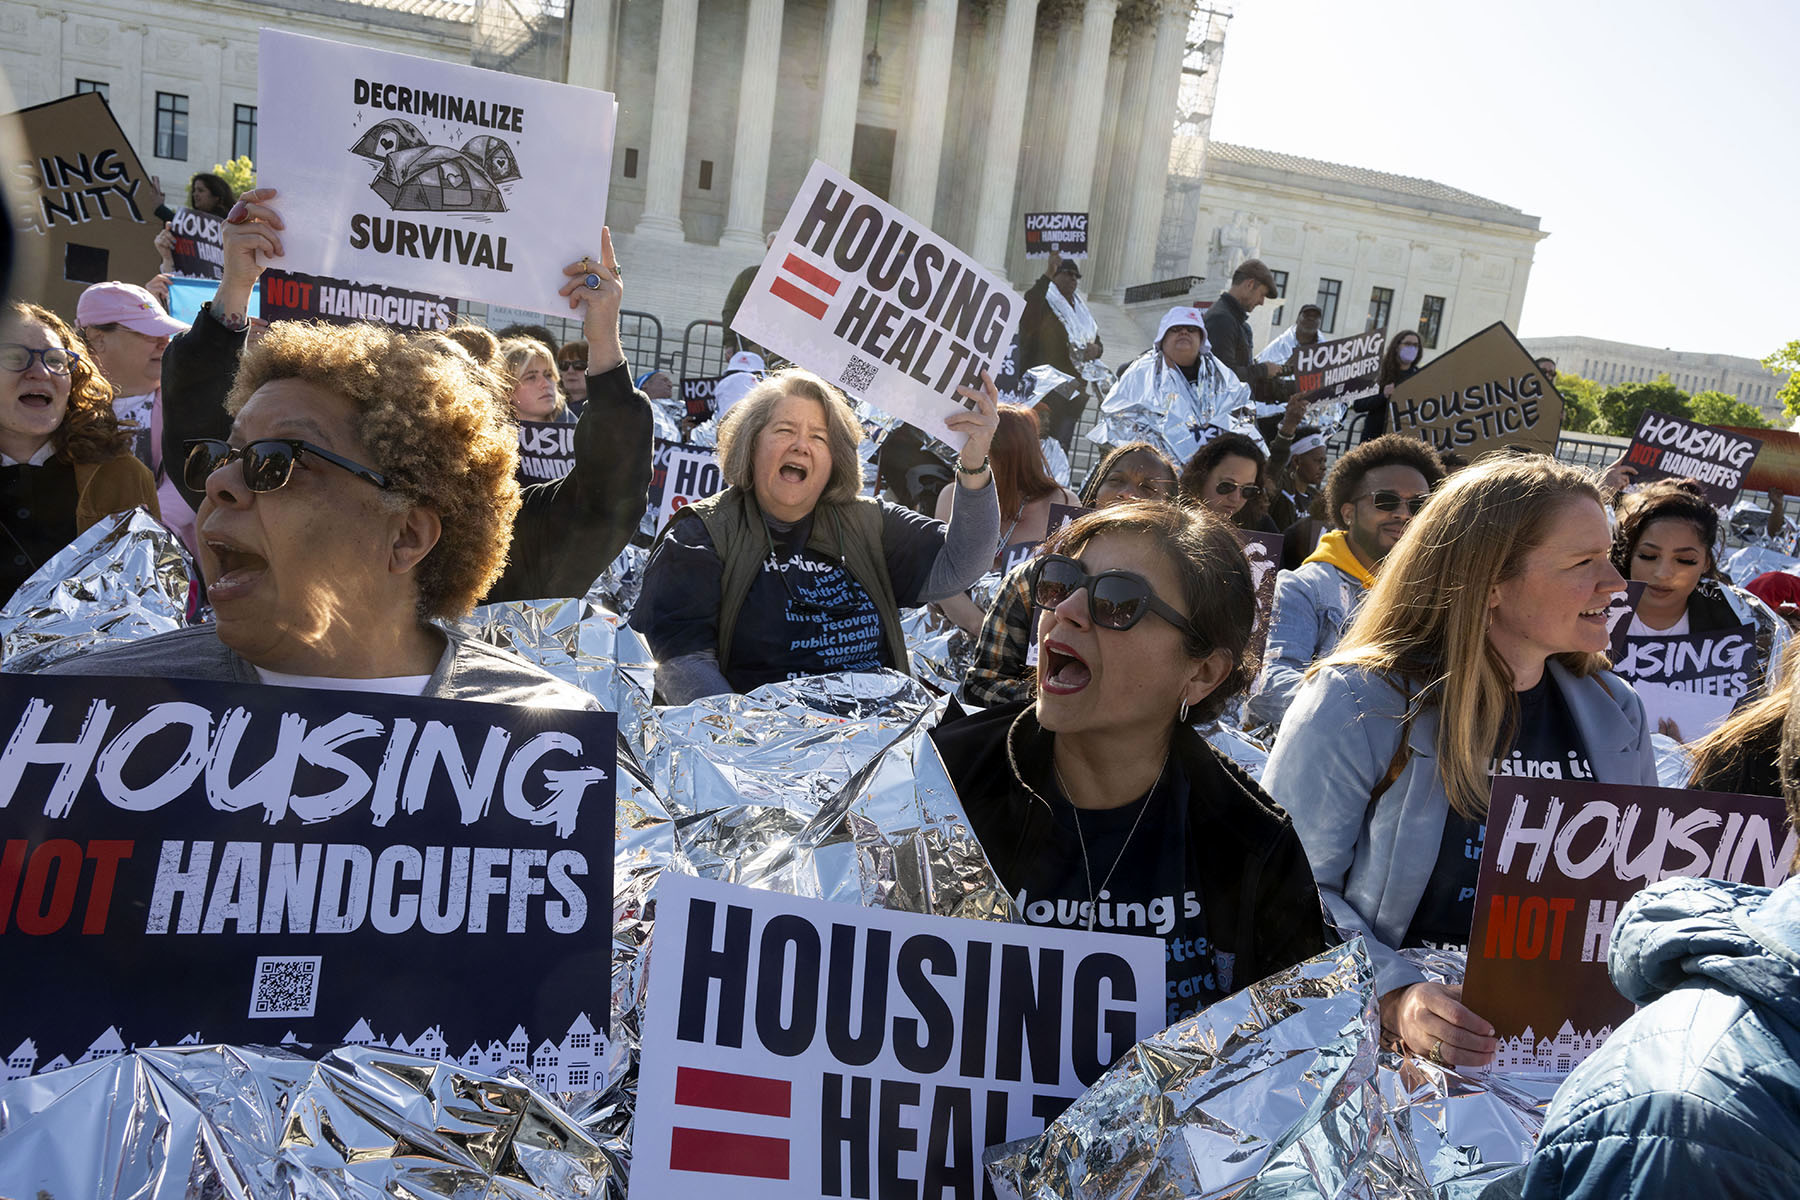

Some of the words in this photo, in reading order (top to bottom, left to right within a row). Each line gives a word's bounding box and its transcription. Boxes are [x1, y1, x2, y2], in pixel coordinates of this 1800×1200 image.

[354, 78, 524, 133] DECRIMINALIZE
[350, 214, 513, 273] SURVIVAL
[1026, 214, 1088, 231] HOUSING
[1041, 230, 1087, 243] HANDCUFFS
[793, 178, 1012, 360] HOUSING
[267, 276, 313, 311] NOT
[319, 285, 450, 331] HANDCUFFS
[833, 285, 990, 411] HEALTH
[1298, 333, 1384, 371] HOUSING
[1299, 372, 1322, 392] NOT
[1324, 356, 1379, 387] HANDCUFFS
[1389, 372, 1543, 433] HOUSING
[1629, 443, 1662, 467] NOT
[1658, 451, 1741, 490] HANDCUFFS
[1639, 415, 1755, 469] HOUSING
[790, 634, 837, 651] public
[838, 626, 880, 643] health
[822, 613, 879, 632] recovery
[0, 697, 608, 839] HOUSING
[145, 840, 589, 935] HANDCUFFS
[1483, 894, 1576, 961] NOT
[676, 897, 1138, 1088] HOUSING
